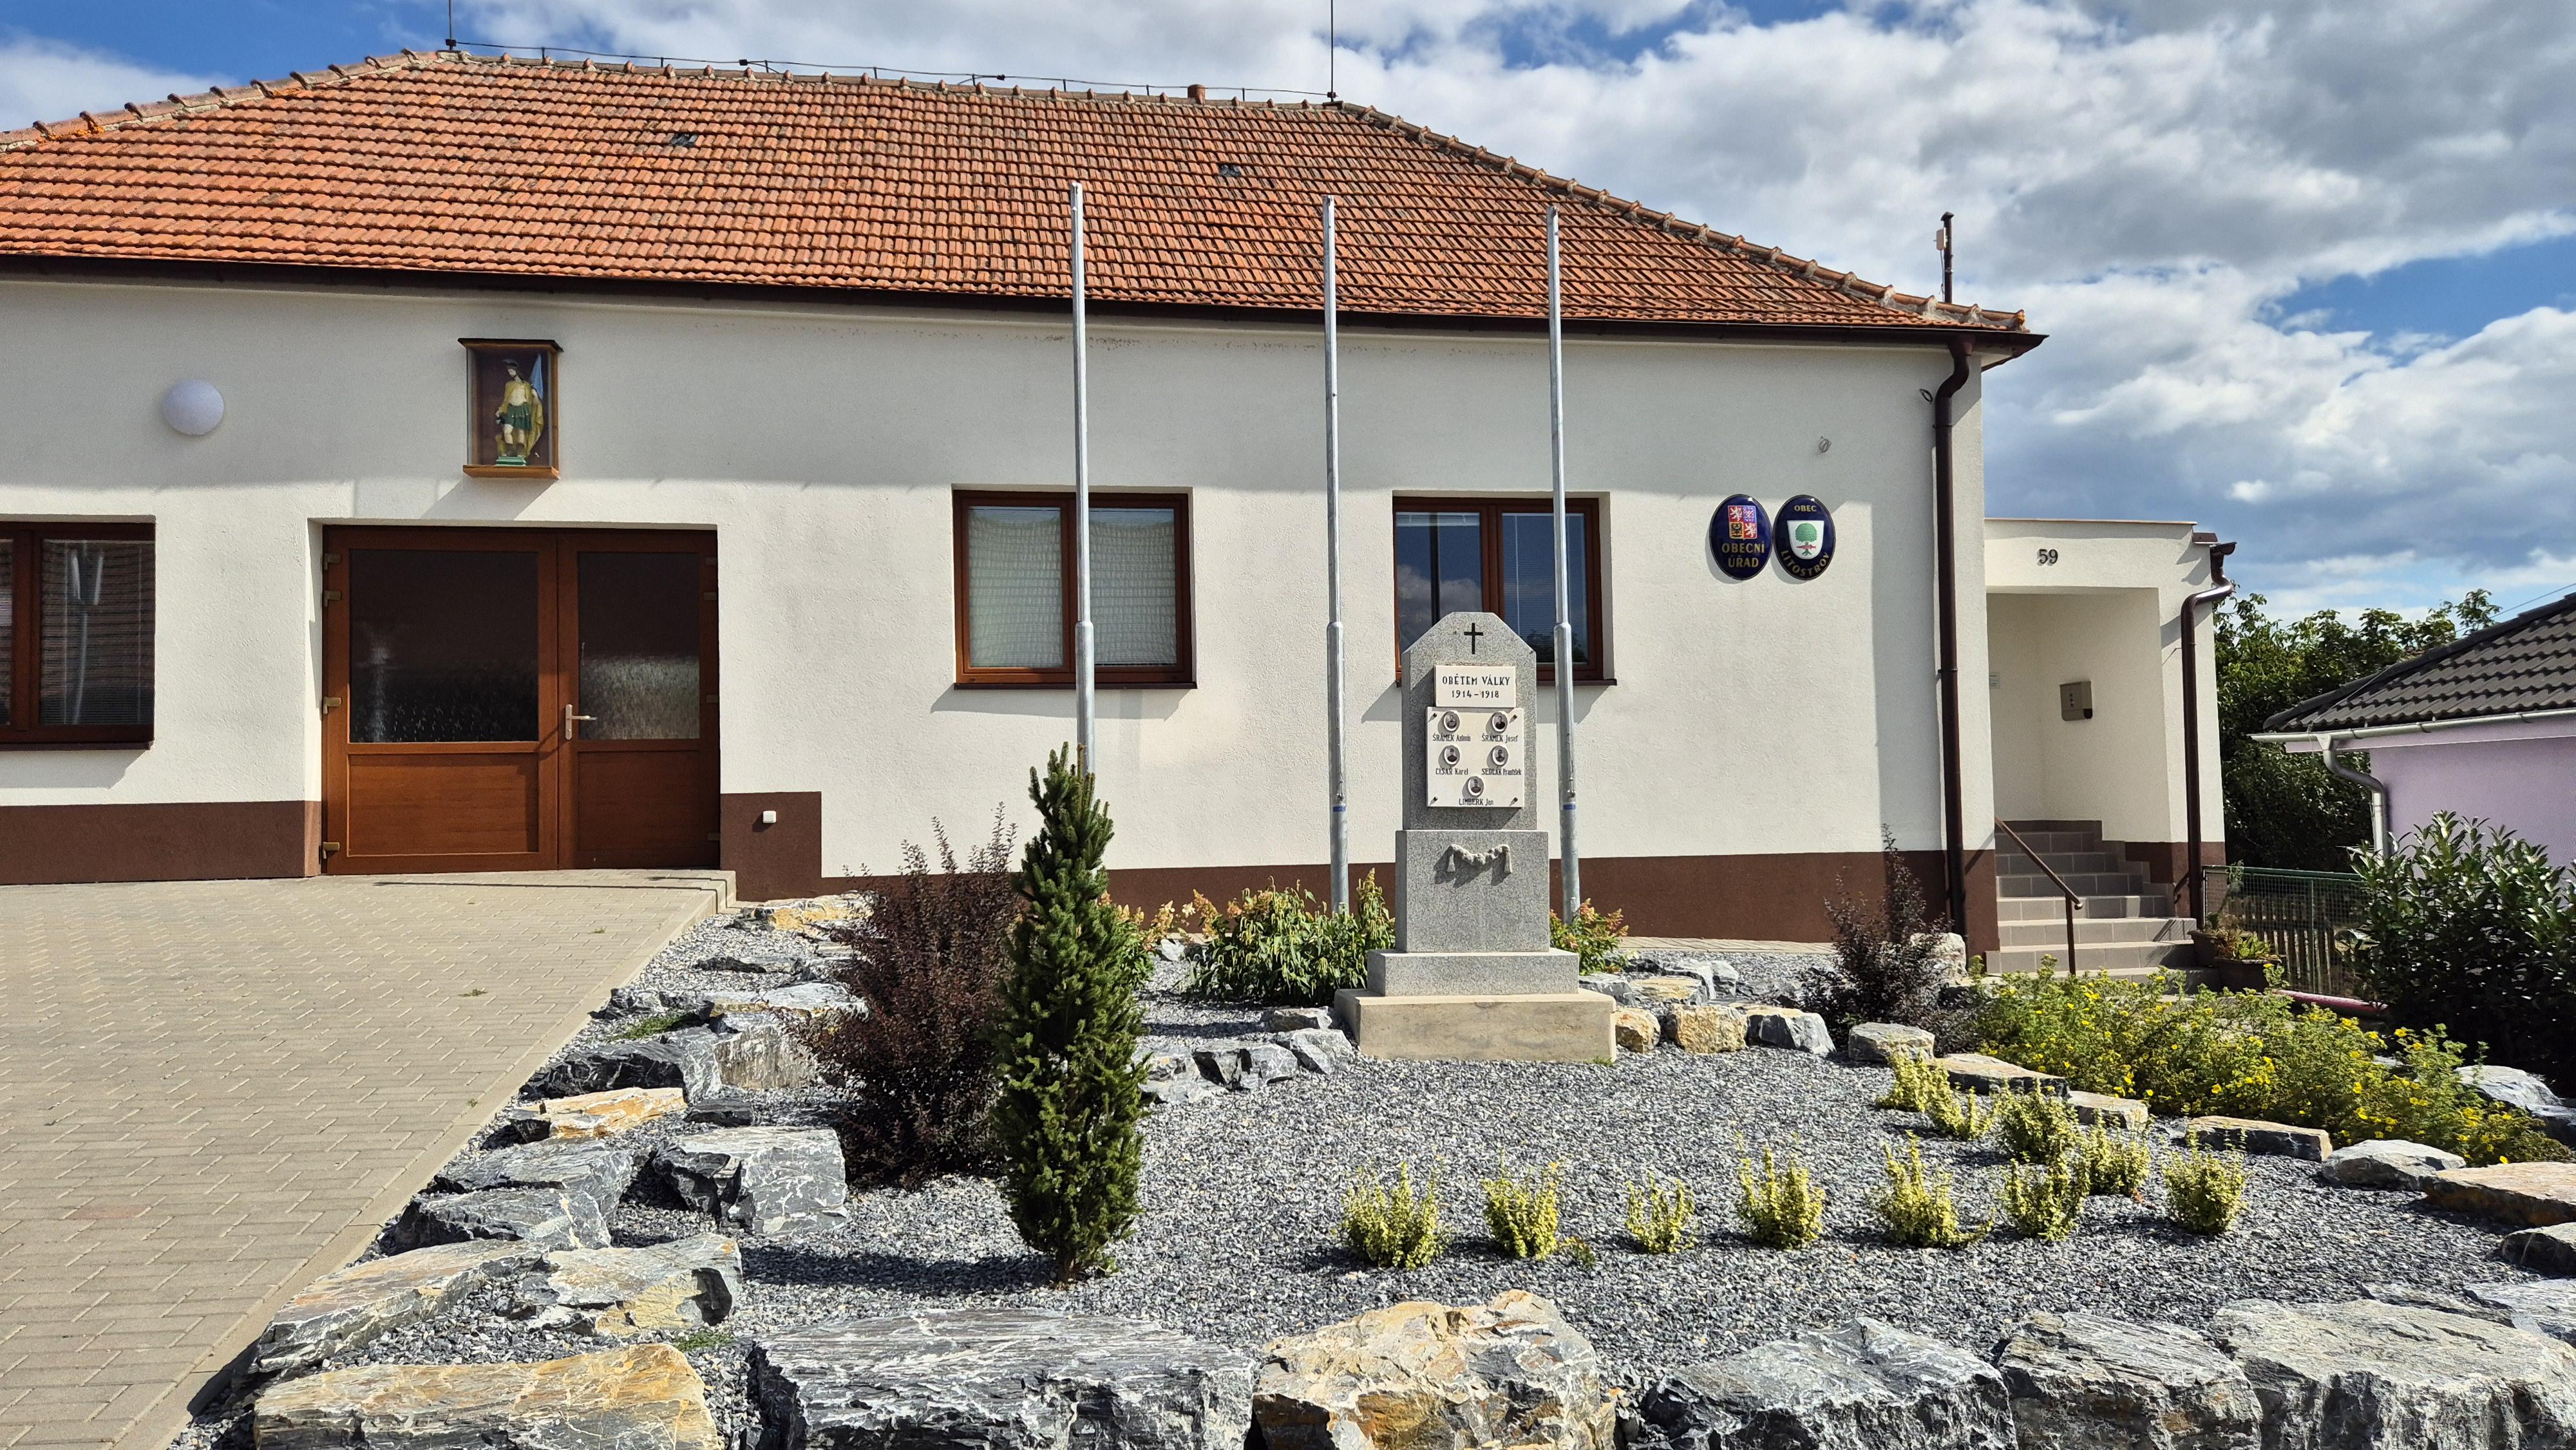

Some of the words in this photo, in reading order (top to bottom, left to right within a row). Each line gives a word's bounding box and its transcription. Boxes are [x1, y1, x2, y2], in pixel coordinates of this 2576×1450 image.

[1794, 504, 1817, 513] OBEC
[1721, 541, 1765, 554] OBECNÍ
[1728, 554, 1759, 568] ÚŘAD
[1781, 550, 1830, 576] LITOSTROV
[2038, 549, 2058, 565] 59
[1442, 673, 1477, 685] OBĚTEM
[1482, 674, 1510, 686] VÁLKY
[1505, 735, 1519, 743] Josef
